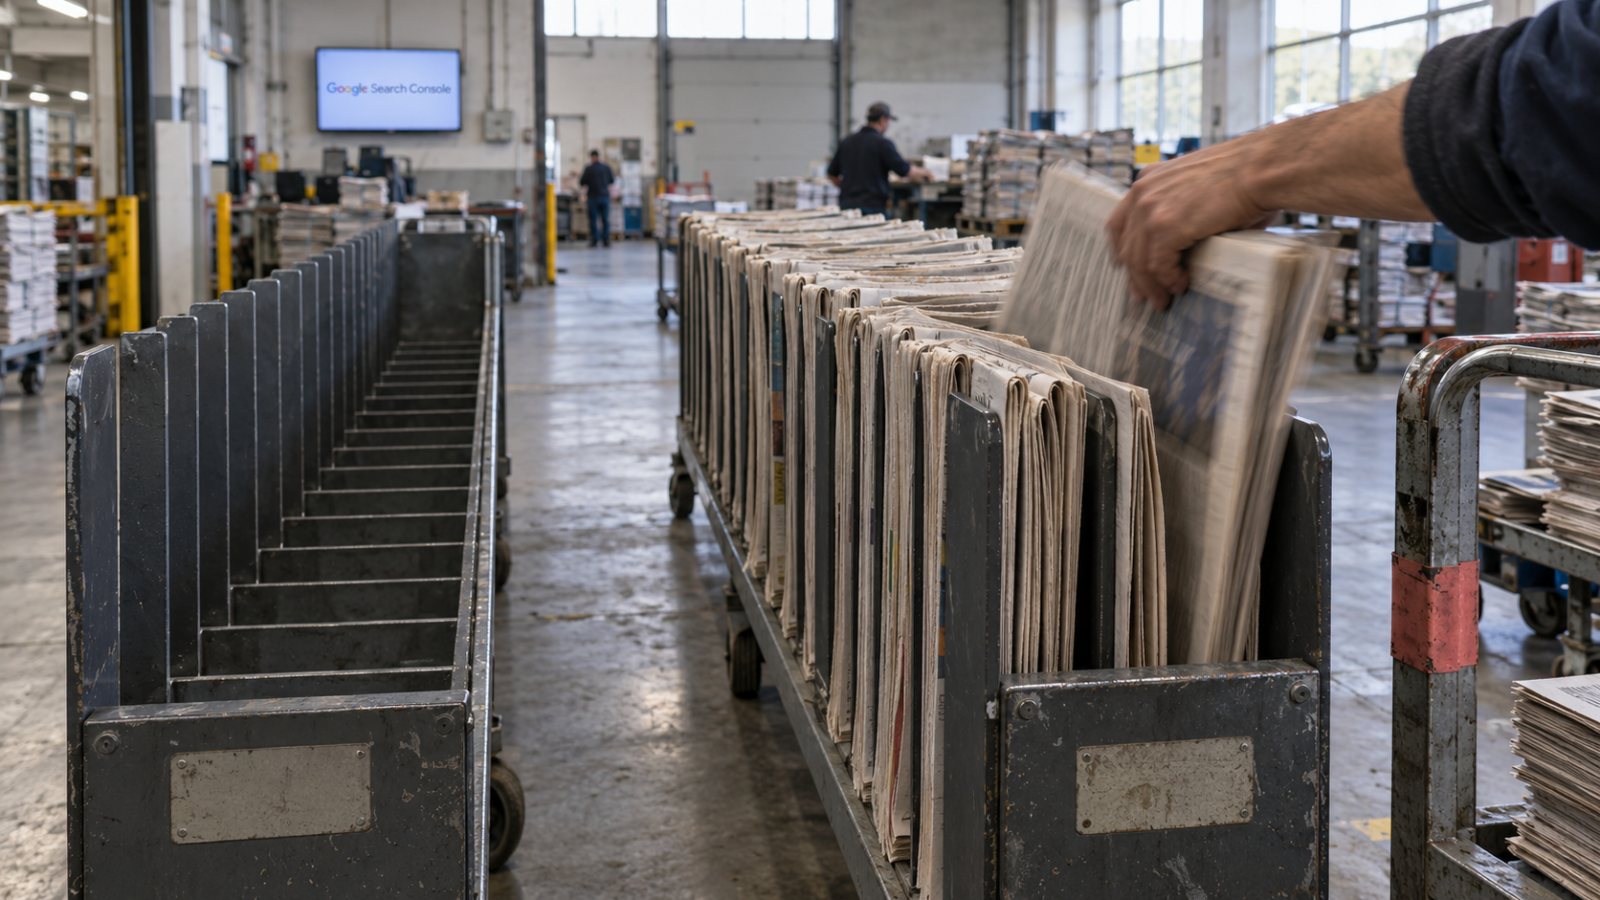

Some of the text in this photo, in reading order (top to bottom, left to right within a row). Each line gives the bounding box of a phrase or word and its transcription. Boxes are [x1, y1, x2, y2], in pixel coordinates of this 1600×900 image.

[326, 82, 452, 96] Google Search Console
